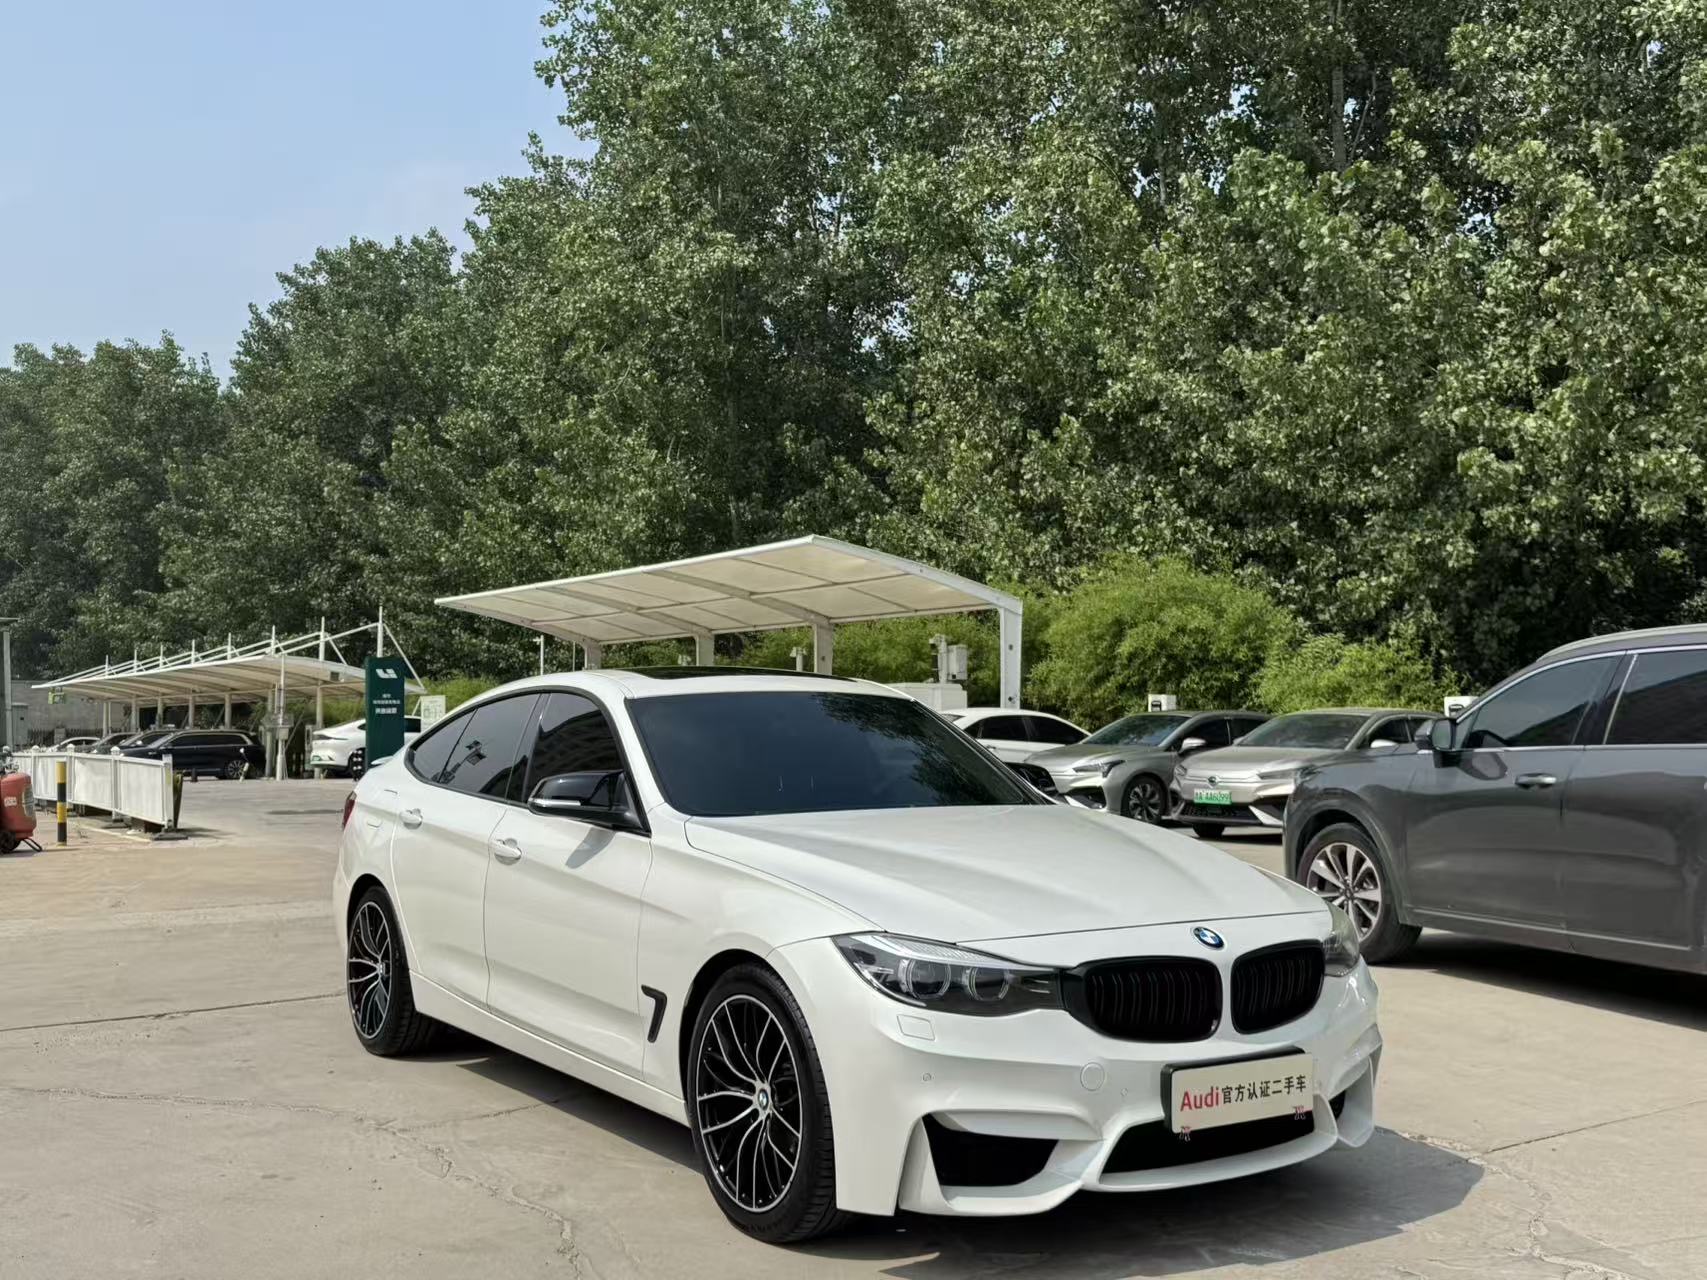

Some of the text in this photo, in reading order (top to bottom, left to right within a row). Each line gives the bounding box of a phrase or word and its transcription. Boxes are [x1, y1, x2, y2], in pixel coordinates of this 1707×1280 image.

[1180, 1074, 1307, 1112] Audi 官方认证二手车
